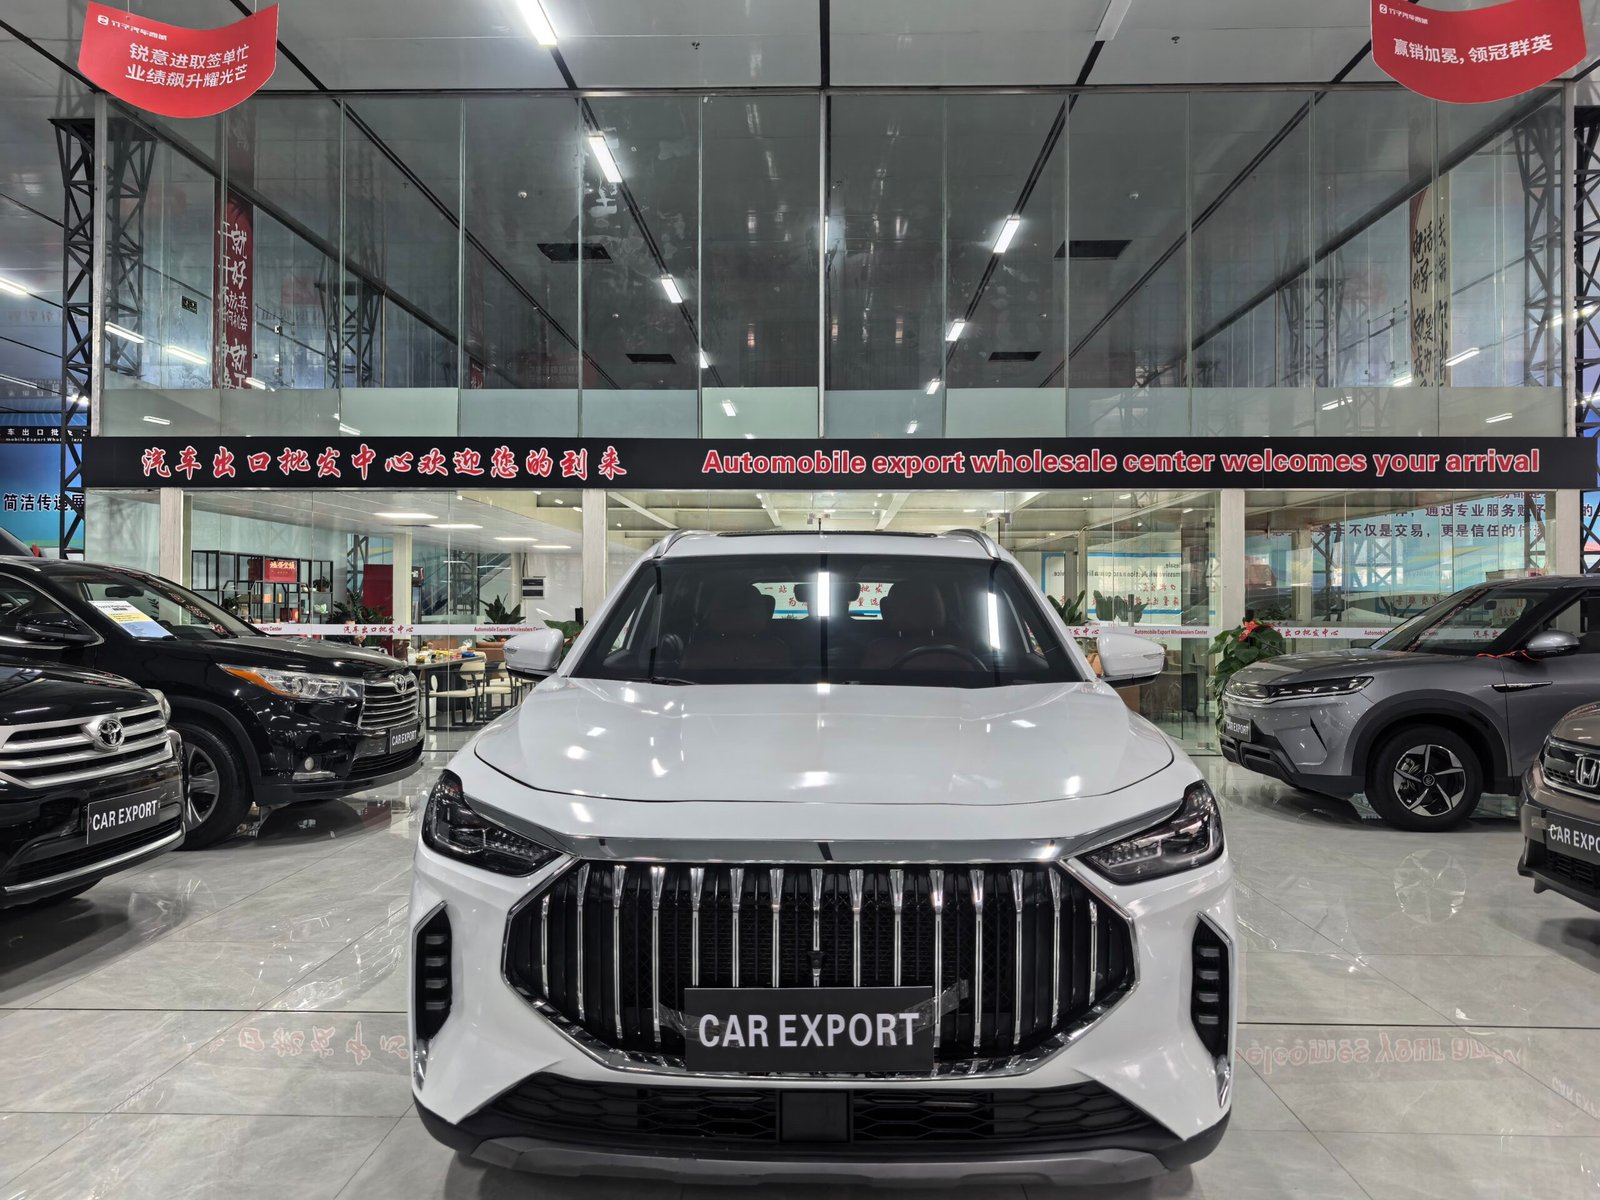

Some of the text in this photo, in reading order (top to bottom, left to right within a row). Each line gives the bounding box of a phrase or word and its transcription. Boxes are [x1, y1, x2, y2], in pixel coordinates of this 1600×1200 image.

[129, 42, 250, 70] 锐意进取签单忙
[126, 64, 247, 89] 业绩飙升耀光芒
[141, 443, 627, 480] 汽车出口批发中心欢迎您的到来
[702, 448, 1540, 478] Automobile export wholesale center welcomes your arrival
[1068, 627, 1100, 636] 发中心
[92, 800, 157, 831] CAR EXPORT
[1550, 824, 1571, 845] CAR
[699, 1012, 919, 1047] CAR EXPORT
